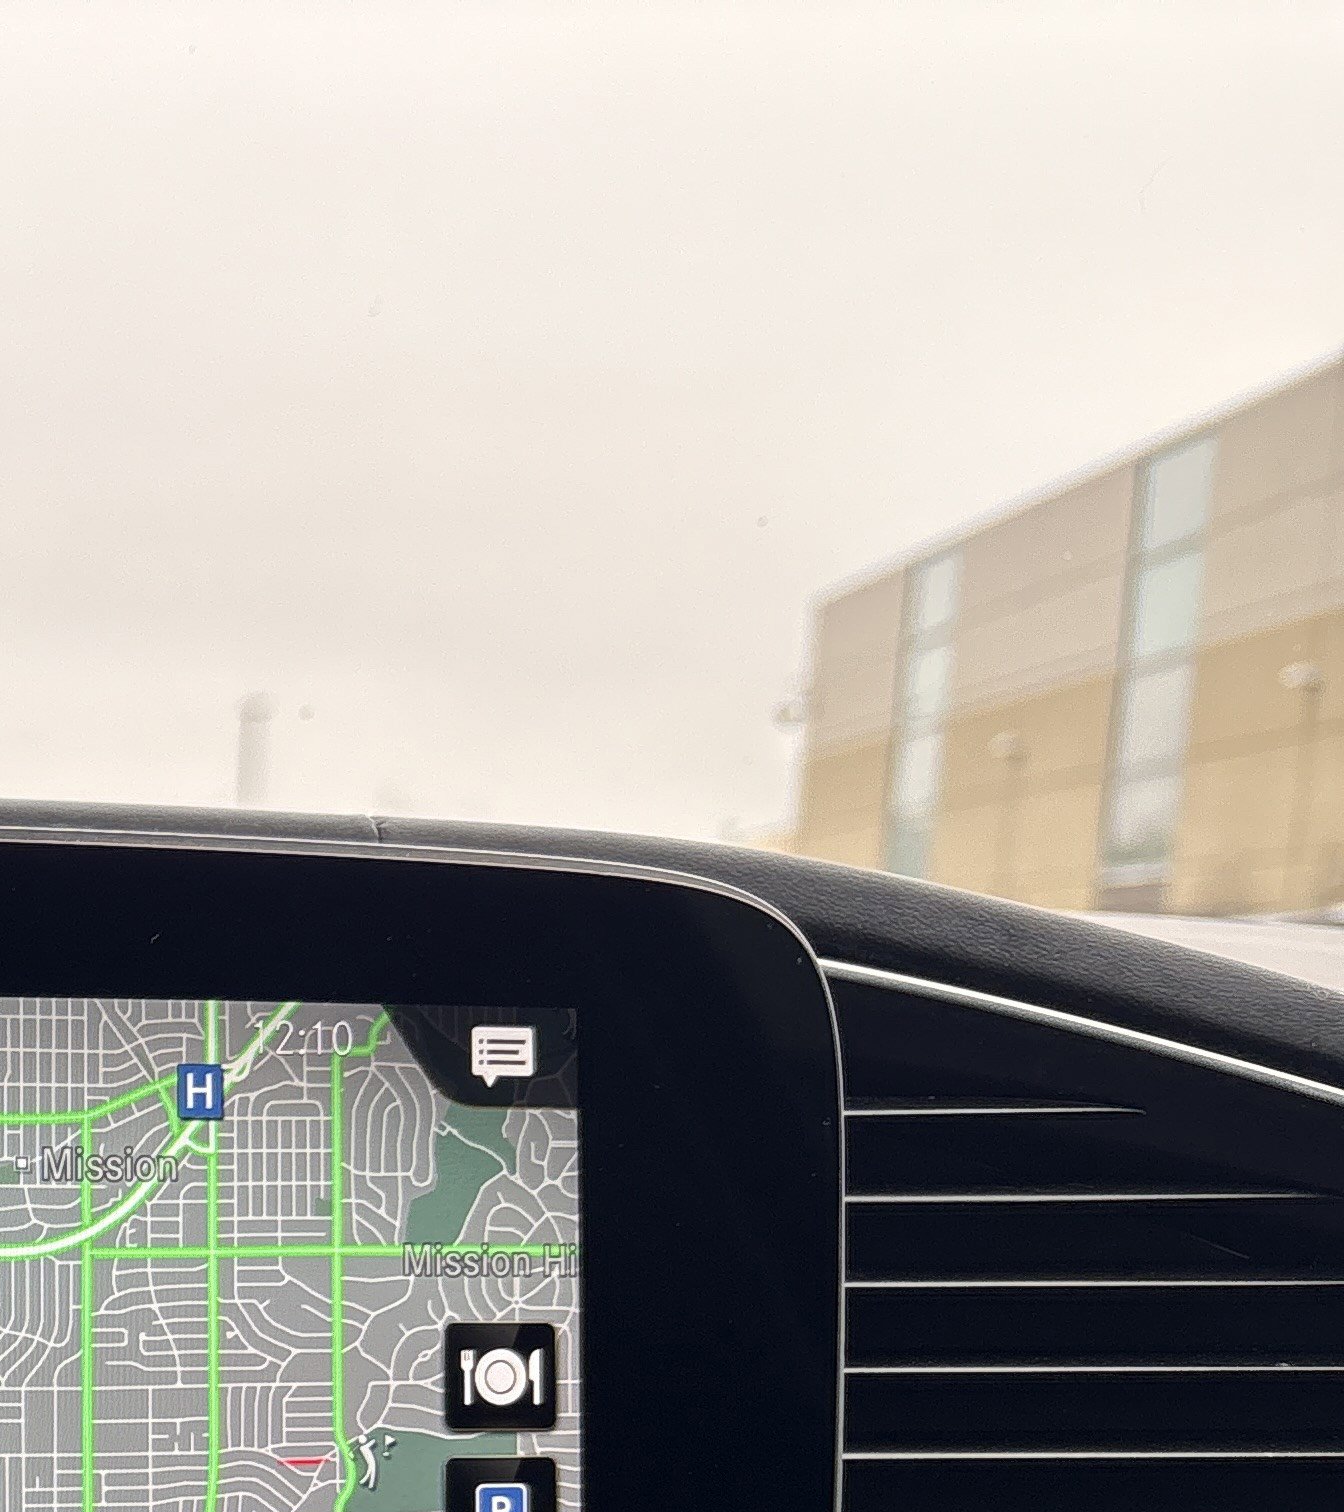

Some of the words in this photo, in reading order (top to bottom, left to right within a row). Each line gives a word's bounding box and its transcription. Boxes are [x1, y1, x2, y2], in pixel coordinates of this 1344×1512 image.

[254, 1020, 353, 1056] 12:10
[186, 1072, 214, 1109] H
[41, 1146, 178, 1183] Mission
[401, 1242, 532, 1278] Mission
[542, 1242, 579, 1278] Hi
